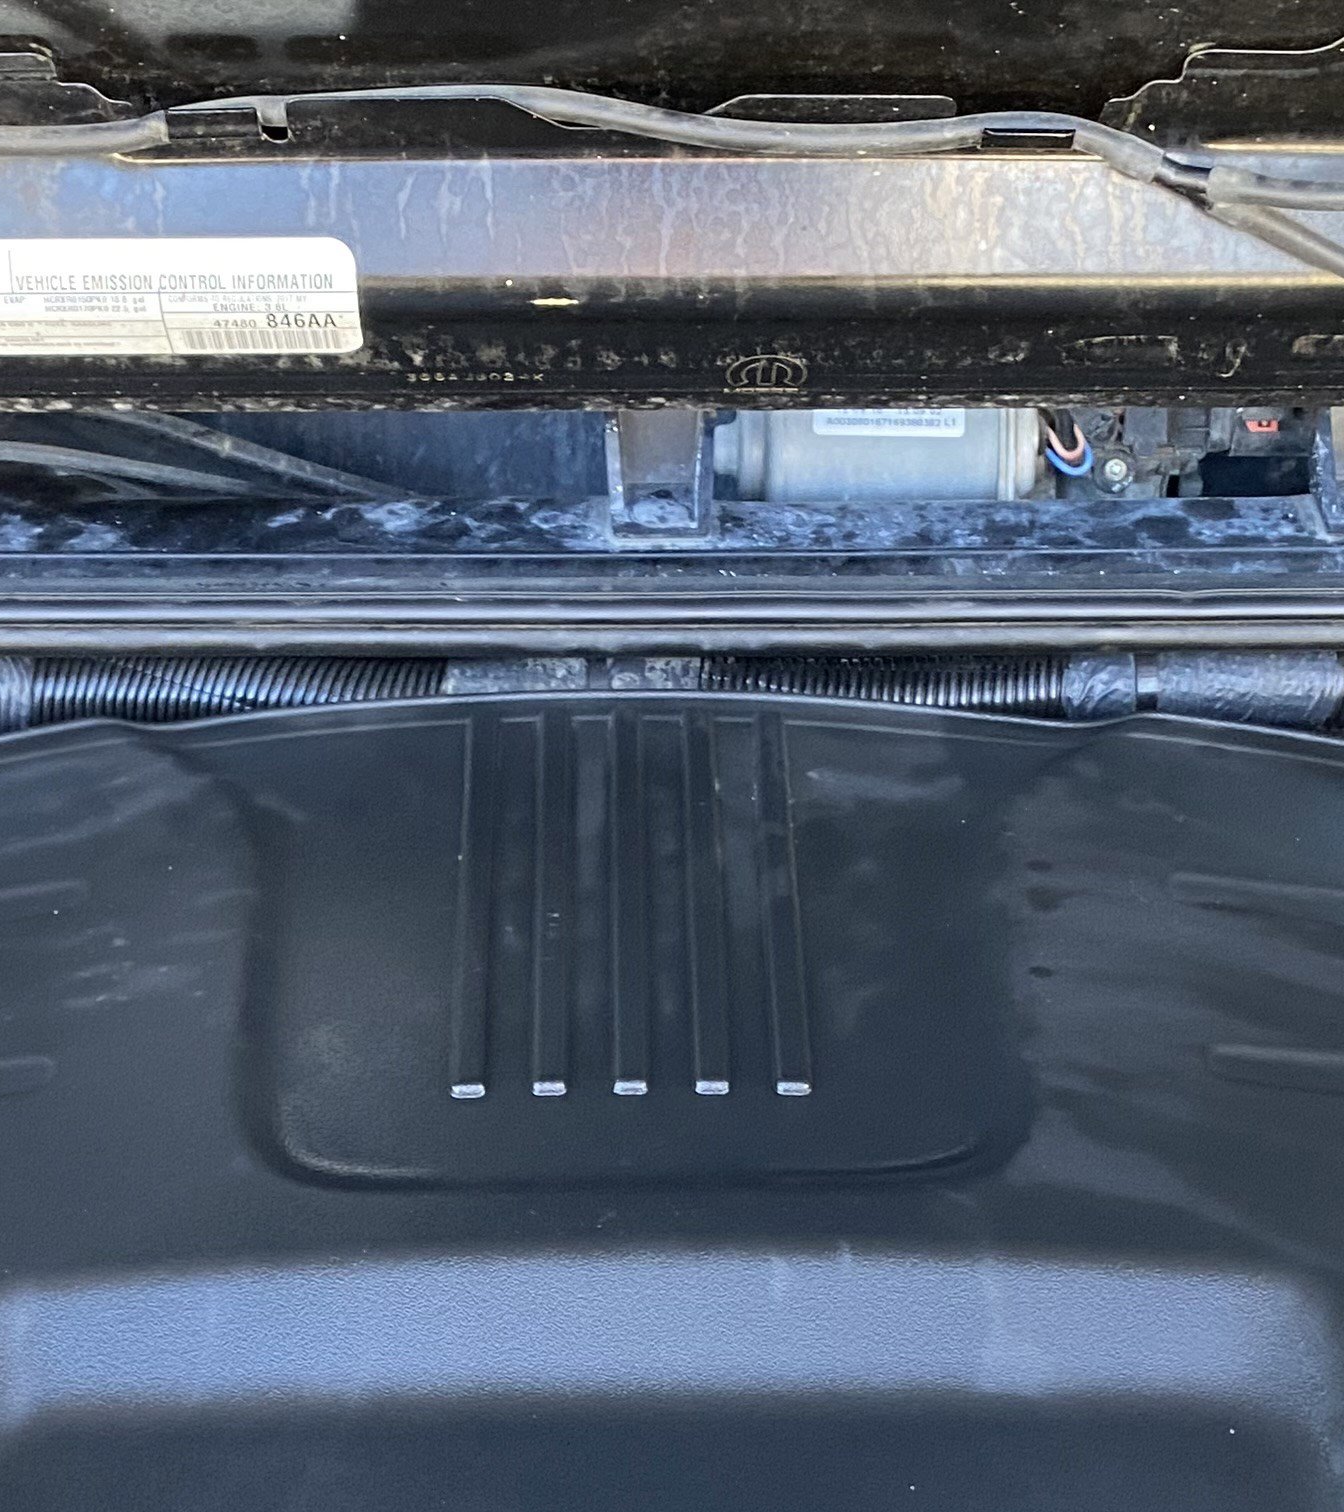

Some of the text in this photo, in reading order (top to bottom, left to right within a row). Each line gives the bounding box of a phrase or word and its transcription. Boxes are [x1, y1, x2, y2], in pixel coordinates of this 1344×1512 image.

[15, 273, 334, 291] VEHICLE EMISSION CONTROL INFORMATION
[266, 313, 338, 329] 846AA
